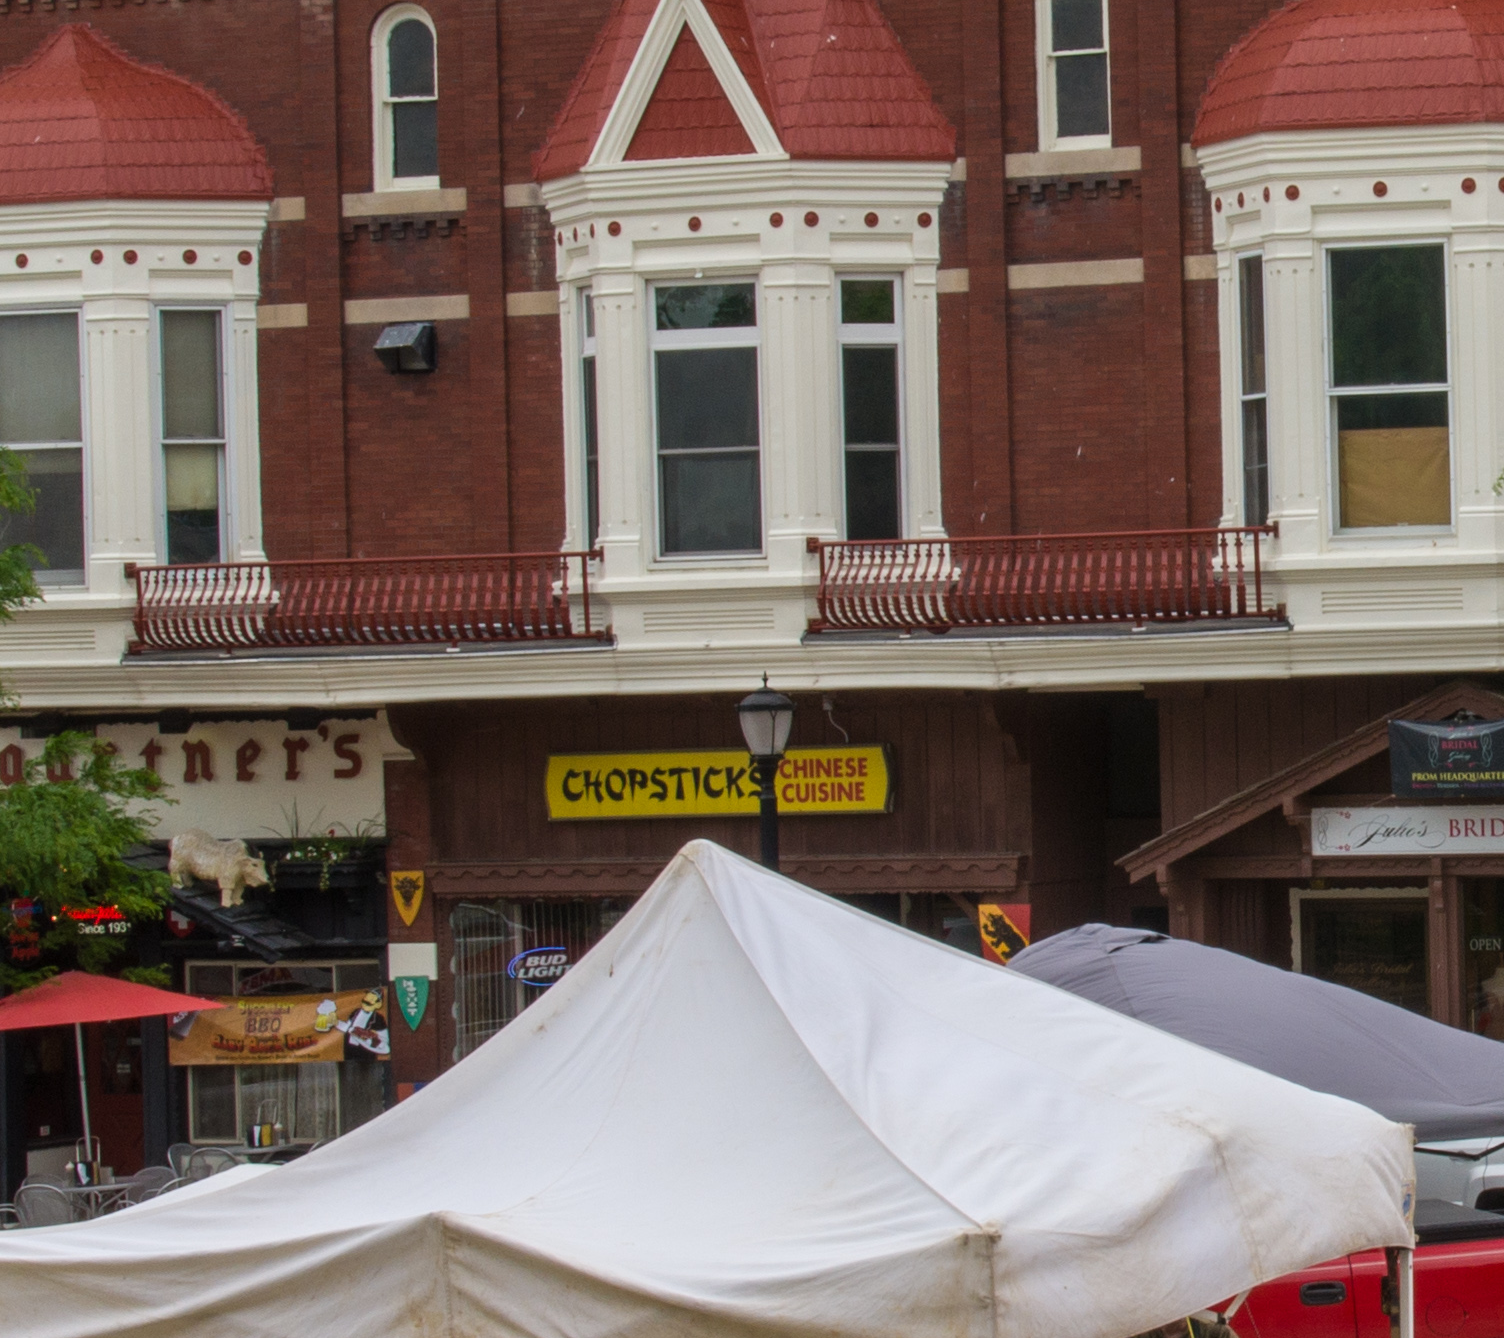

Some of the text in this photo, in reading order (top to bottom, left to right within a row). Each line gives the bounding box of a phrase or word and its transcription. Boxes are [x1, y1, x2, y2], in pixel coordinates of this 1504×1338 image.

[1441, 740, 1478, 750] BRIDAL
[562, 757, 868, 803] CHOPSTICKS CHINESE
[1411, 772, 1438, 782] PROM
[782, 781, 865, 803] CUISINE
[1349, 814, 1446, 849] Julie's
[1469, 938, 1502, 951] OPEN
[525, 954, 567, 967] BUD
[517, 964, 574, 978] LIGHT
[246, 1017, 282, 1034] BBQ
